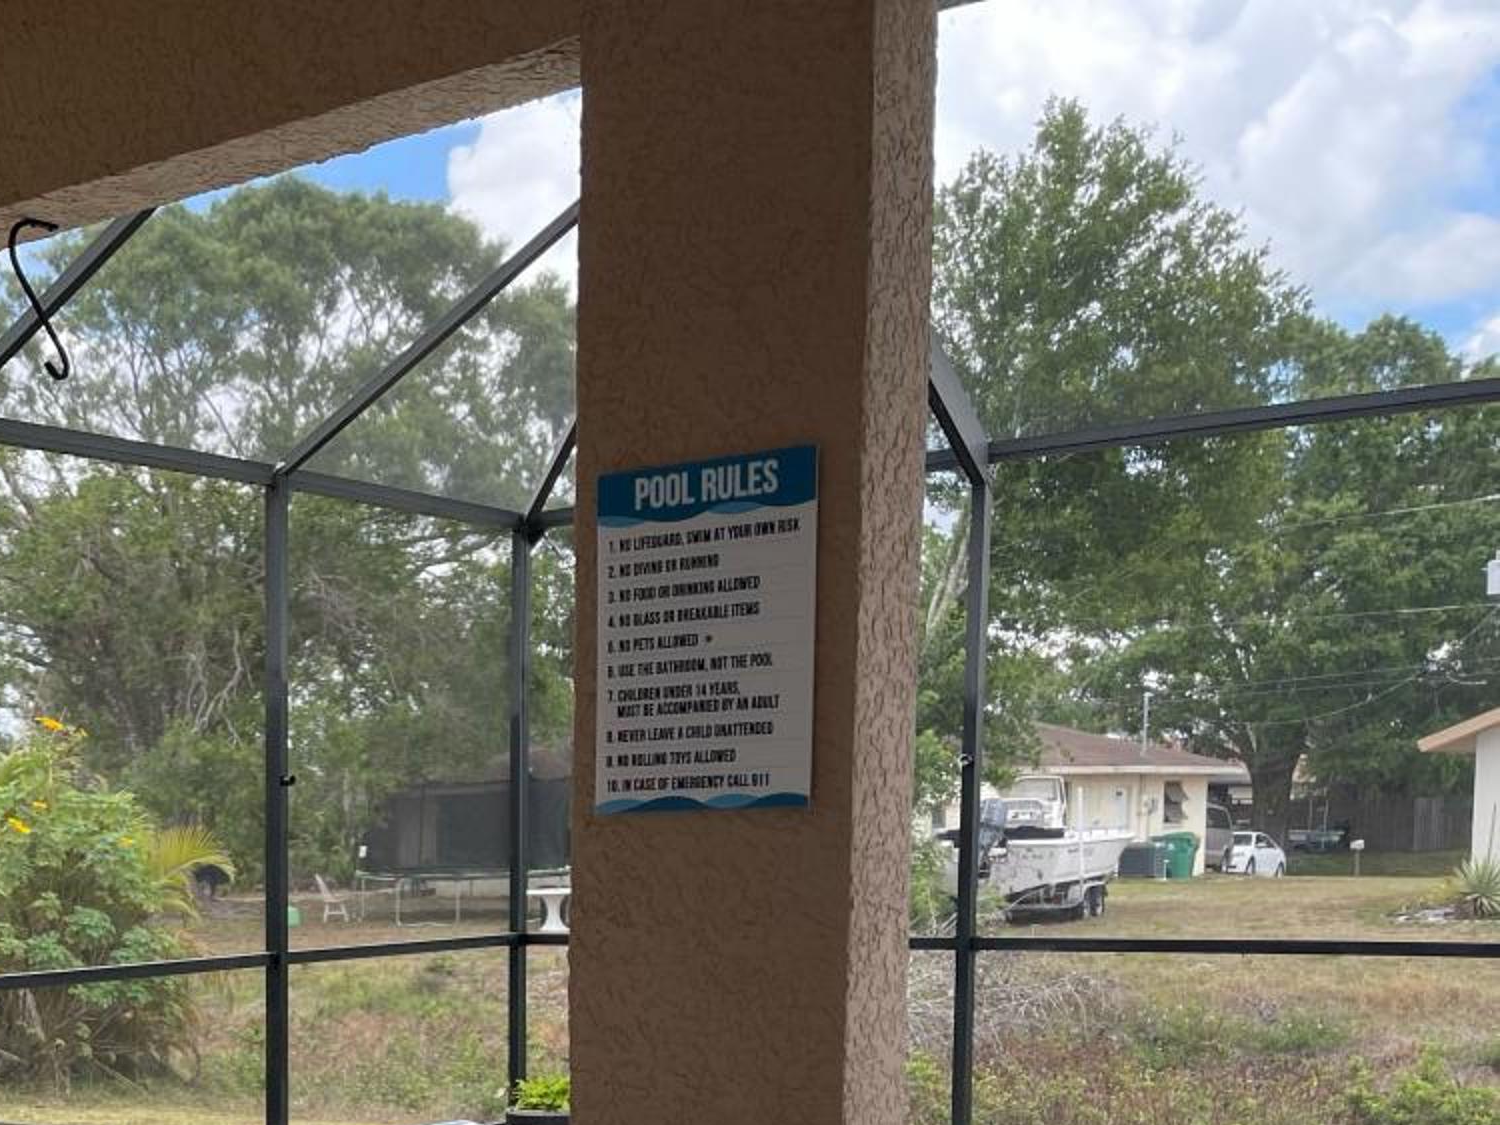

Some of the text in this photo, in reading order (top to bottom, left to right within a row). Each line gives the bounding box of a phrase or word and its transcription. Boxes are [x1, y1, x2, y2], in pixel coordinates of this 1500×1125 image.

[634, 459, 779, 511] POOL RULES
[619, 538, 631, 552] NO
[686, 529, 712, 544] SWIM
[714, 528, 727, 541] AT
[728, 524, 752, 540] YOUR
[754, 520, 775, 536] OWN
[608, 554, 719, 579] 2. NO DIVING OR RUNNING
[608, 575, 761, 604] 3. NO FOOD OR DRINKING ALLOWED
[608, 601, 760, 628] 4. NO GLASS OR BREAKABLE ITEMS
[619, 637, 630, 651] NO
[633, 635, 656, 650] PETS
[657, 634, 699, 650] ALLOWED
[618, 664, 634, 678] USE
[637, 661, 654, 676] THE
[710, 656, 729, 670] NOT
[731, 655, 748, 669] THE
[617, 684, 661, 702] CHILDREN
[662, 683, 693, 699] UNDER
[695, 684, 707, 698] 14
[617, 694, 780, 718] MUST BE ACCOMPANIED BY AN ADULT
[617, 728, 646, 743] NEVER
[648, 726, 678, 741] LEAVE
[678, 726, 684, 740] A
[686, 724, 712, 739] CHILD
[714, 721, 773, 737] UNATTENDED
[617, 754, 630, 767] NO
[632, 751, 667, 767] ROLLING
[670, 751, 692, 764] TOYS
[694, 748, 737, 763] ALLOWED
[622, 779, 632, 792] IN
[634, 777, 658, 791] CASE
[658, 777, 671, 790] OF
[671, 773, 725, 789] EMERGENCY
[727, 773, 750, 788] CALL
[751, 772, 770, 787] 911
